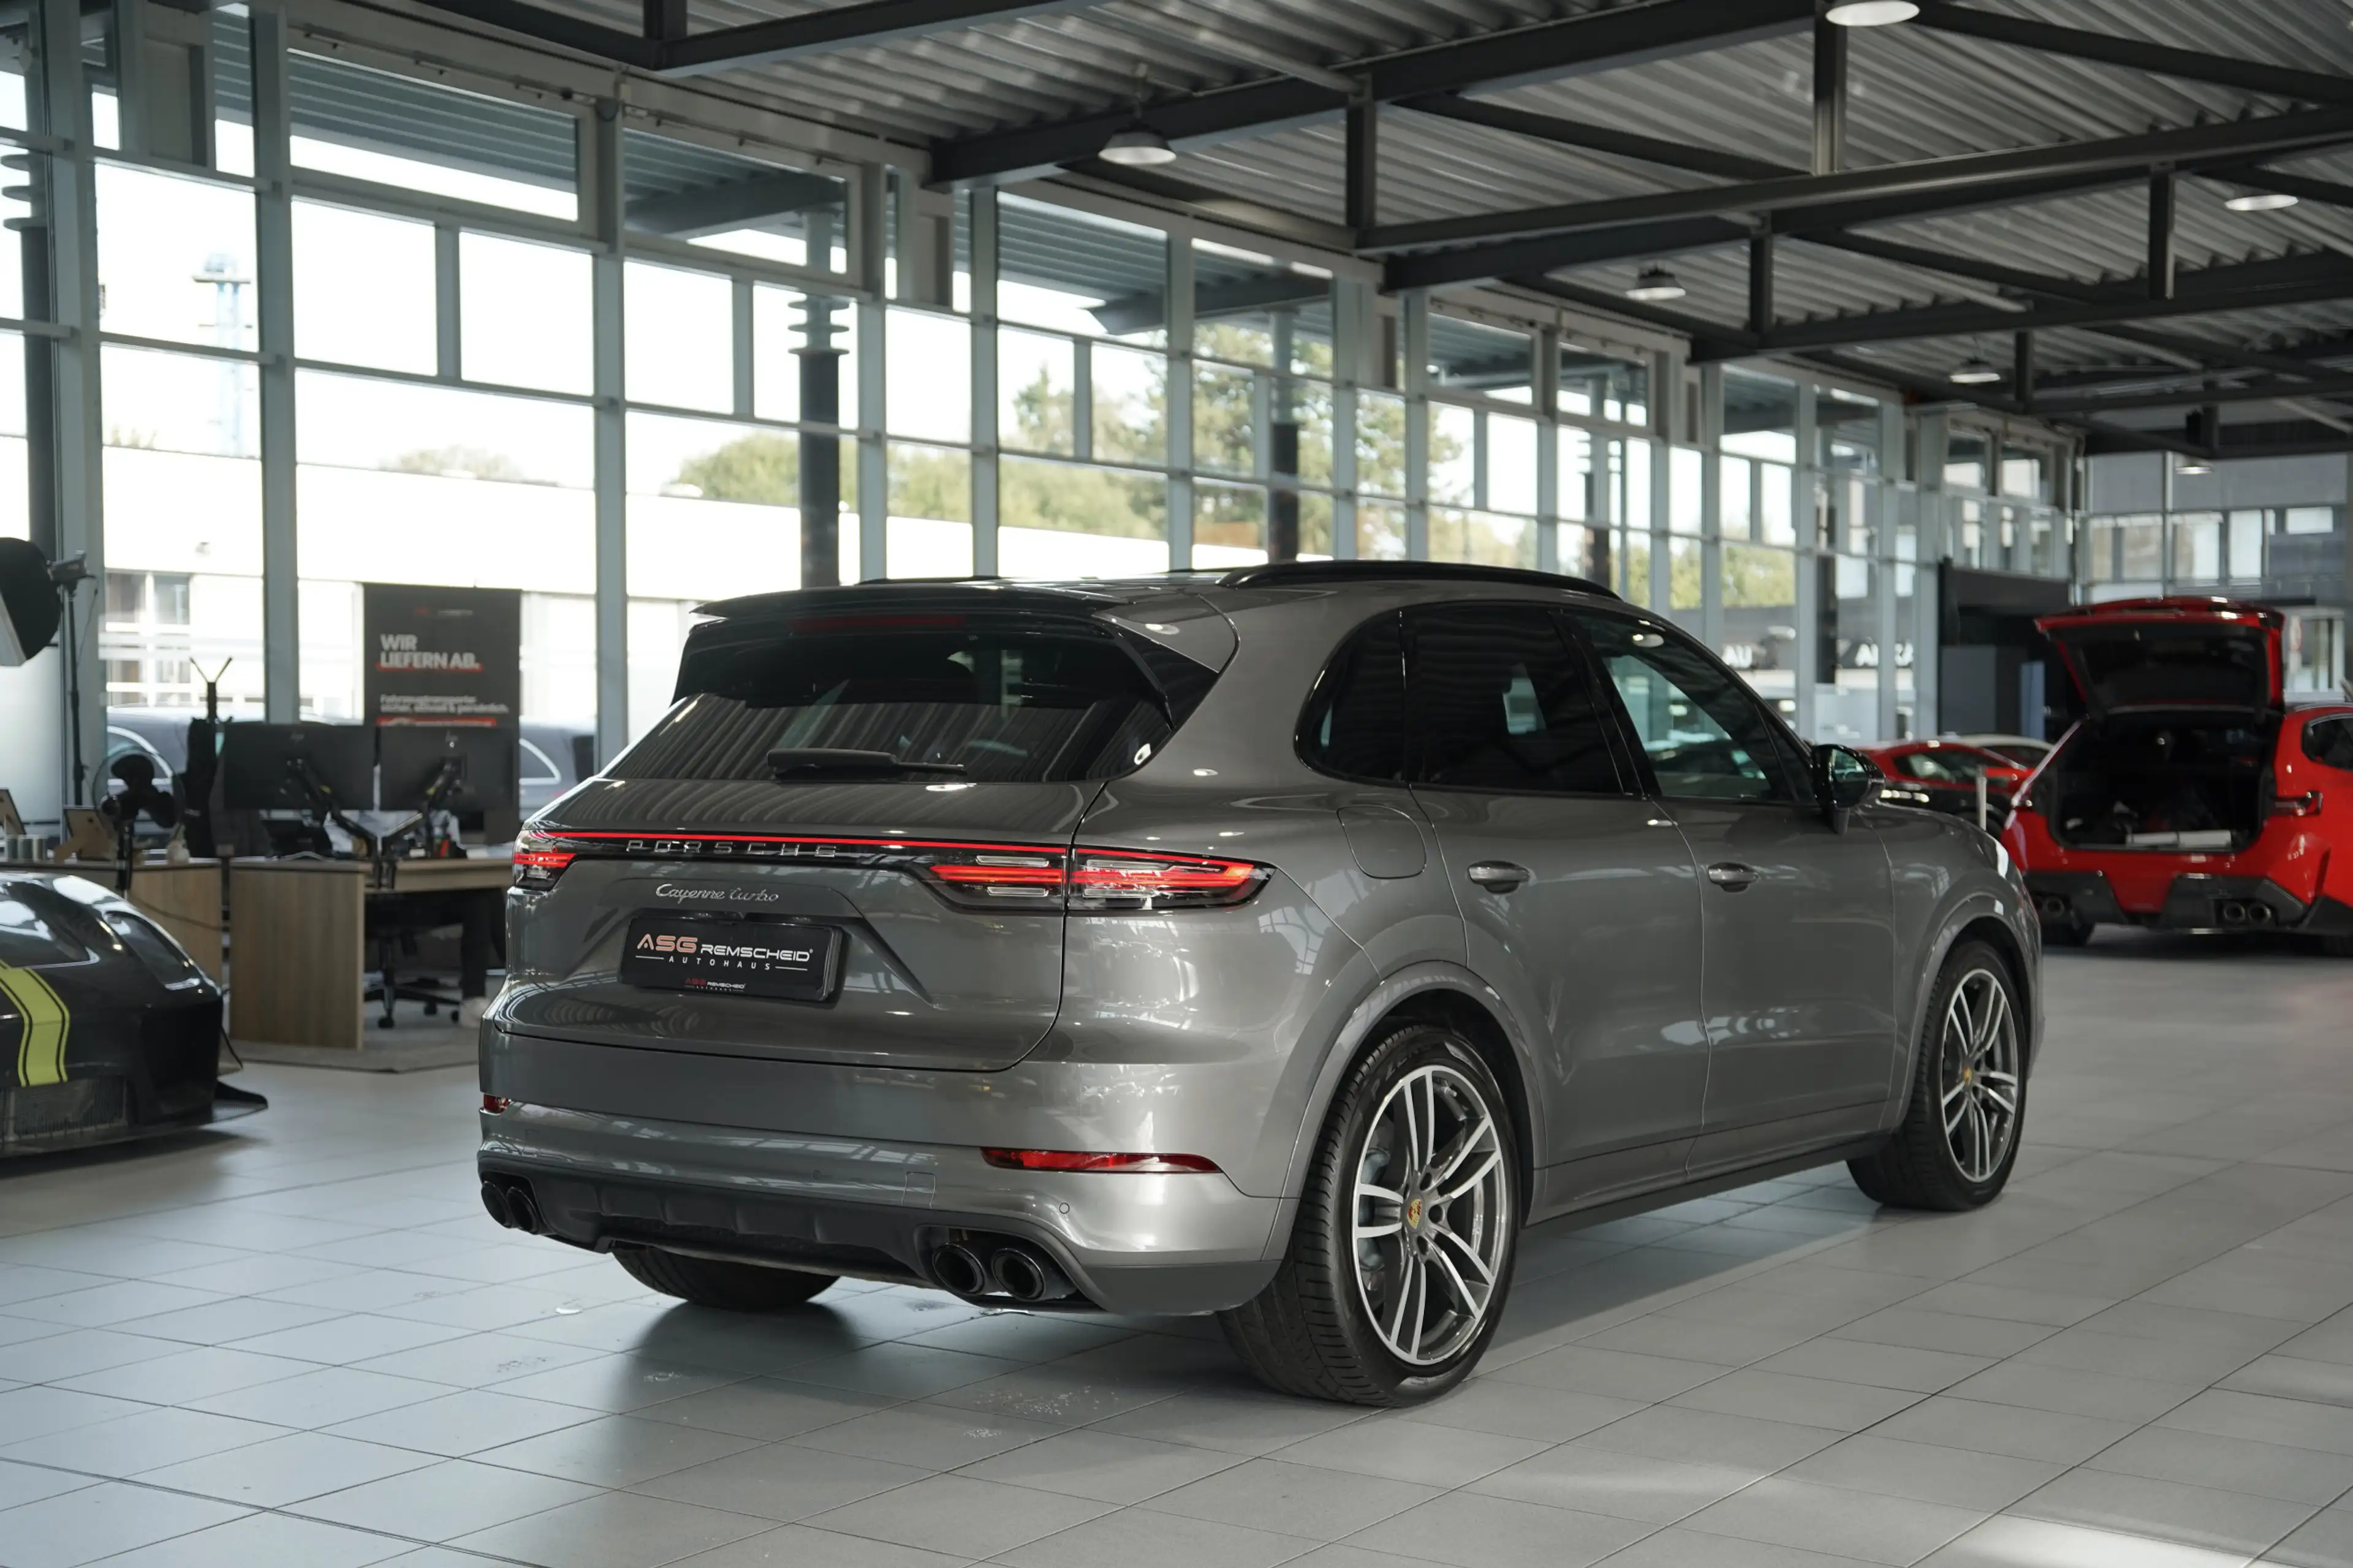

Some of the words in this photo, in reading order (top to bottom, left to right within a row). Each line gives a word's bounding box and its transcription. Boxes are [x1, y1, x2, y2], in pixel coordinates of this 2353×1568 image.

[380, 634, 418, 651] WIR
[380, 651, 448, 668] LIEFERN
[626, 839, 837, 858] PORSCHE
[656, 884, 725, 904] Cayenne
[637, 934, 698, 953] ASG
[669, 955, 770, 970] AUTOHAUS
